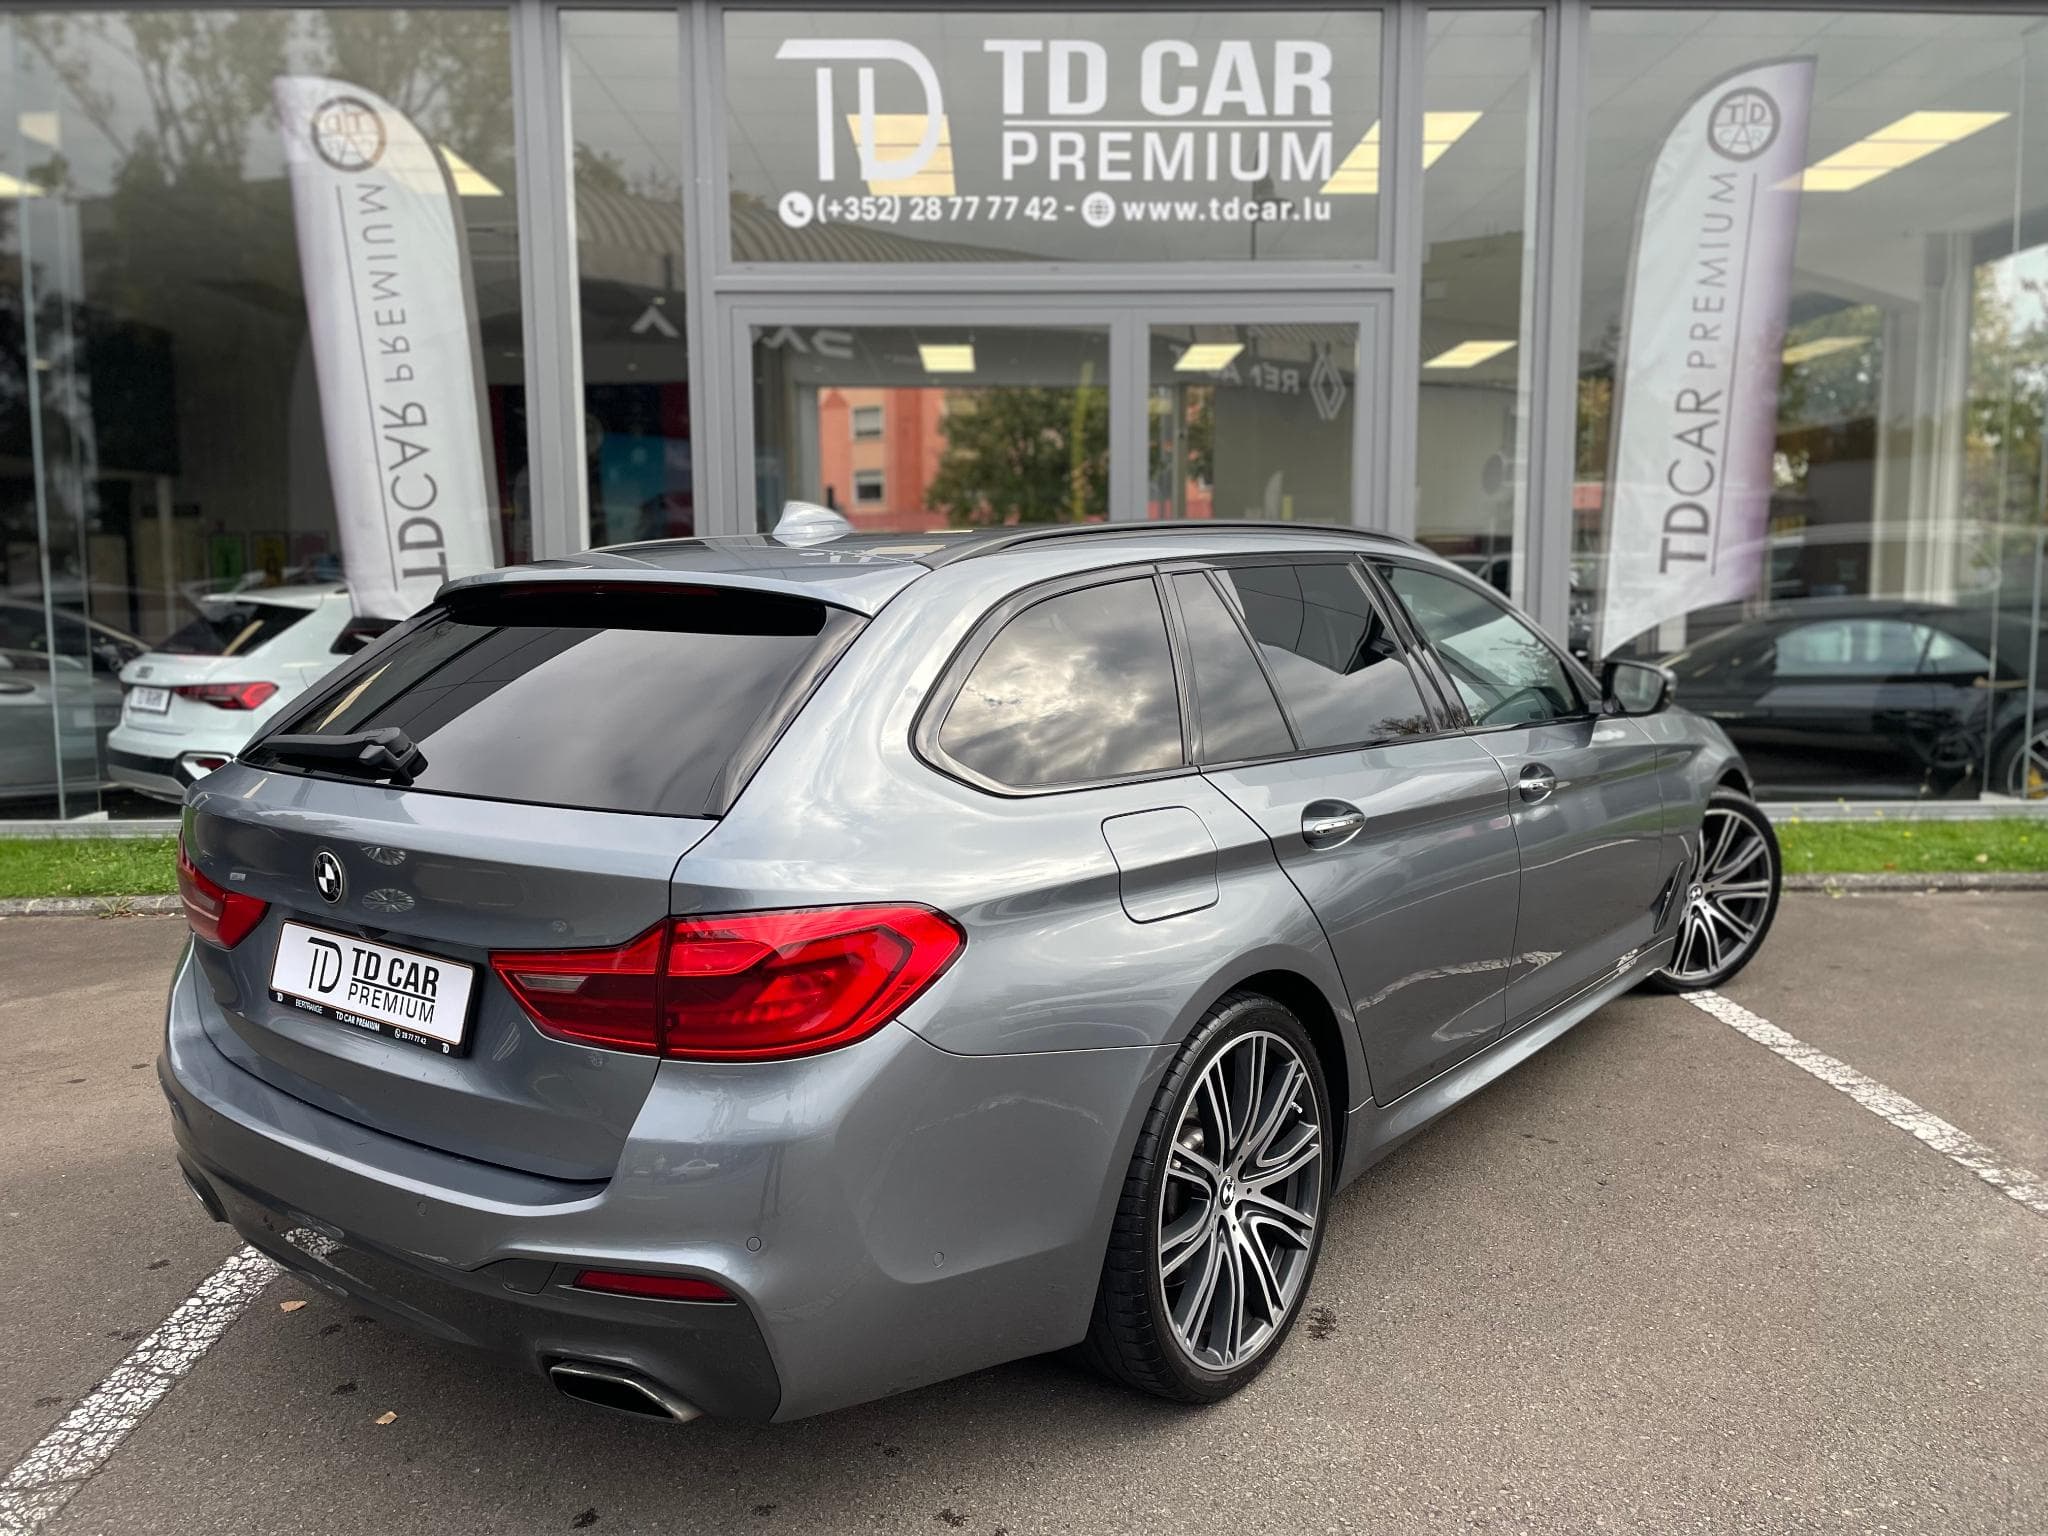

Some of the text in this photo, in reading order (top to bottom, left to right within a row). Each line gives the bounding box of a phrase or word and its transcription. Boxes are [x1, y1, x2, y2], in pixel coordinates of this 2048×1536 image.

[984, 39, 1333, 117] TD CAR
[1003, 131, 1333, 182] PREMIUM
[816, 195, 901, 223] (+352)
[909, 197, 943, 221] 28
[950, 197, 980, 221] 77
[986, 197, 1020, 221] 77
[1024, 197, 1059, 221] 42
[1121, 196, 1332, 222] www.tdcar.lu
[1686, 172, 1739, 370] PREMIUM
[352, 947, 440, 997] TD CAR
[335, 1011, 344, 1020] TD
[344, 1013, 355, 1025] CAR
[355, 1015, 380, 1031] PREMIUM
[348, 983, 436, 1025] PREMIUM
